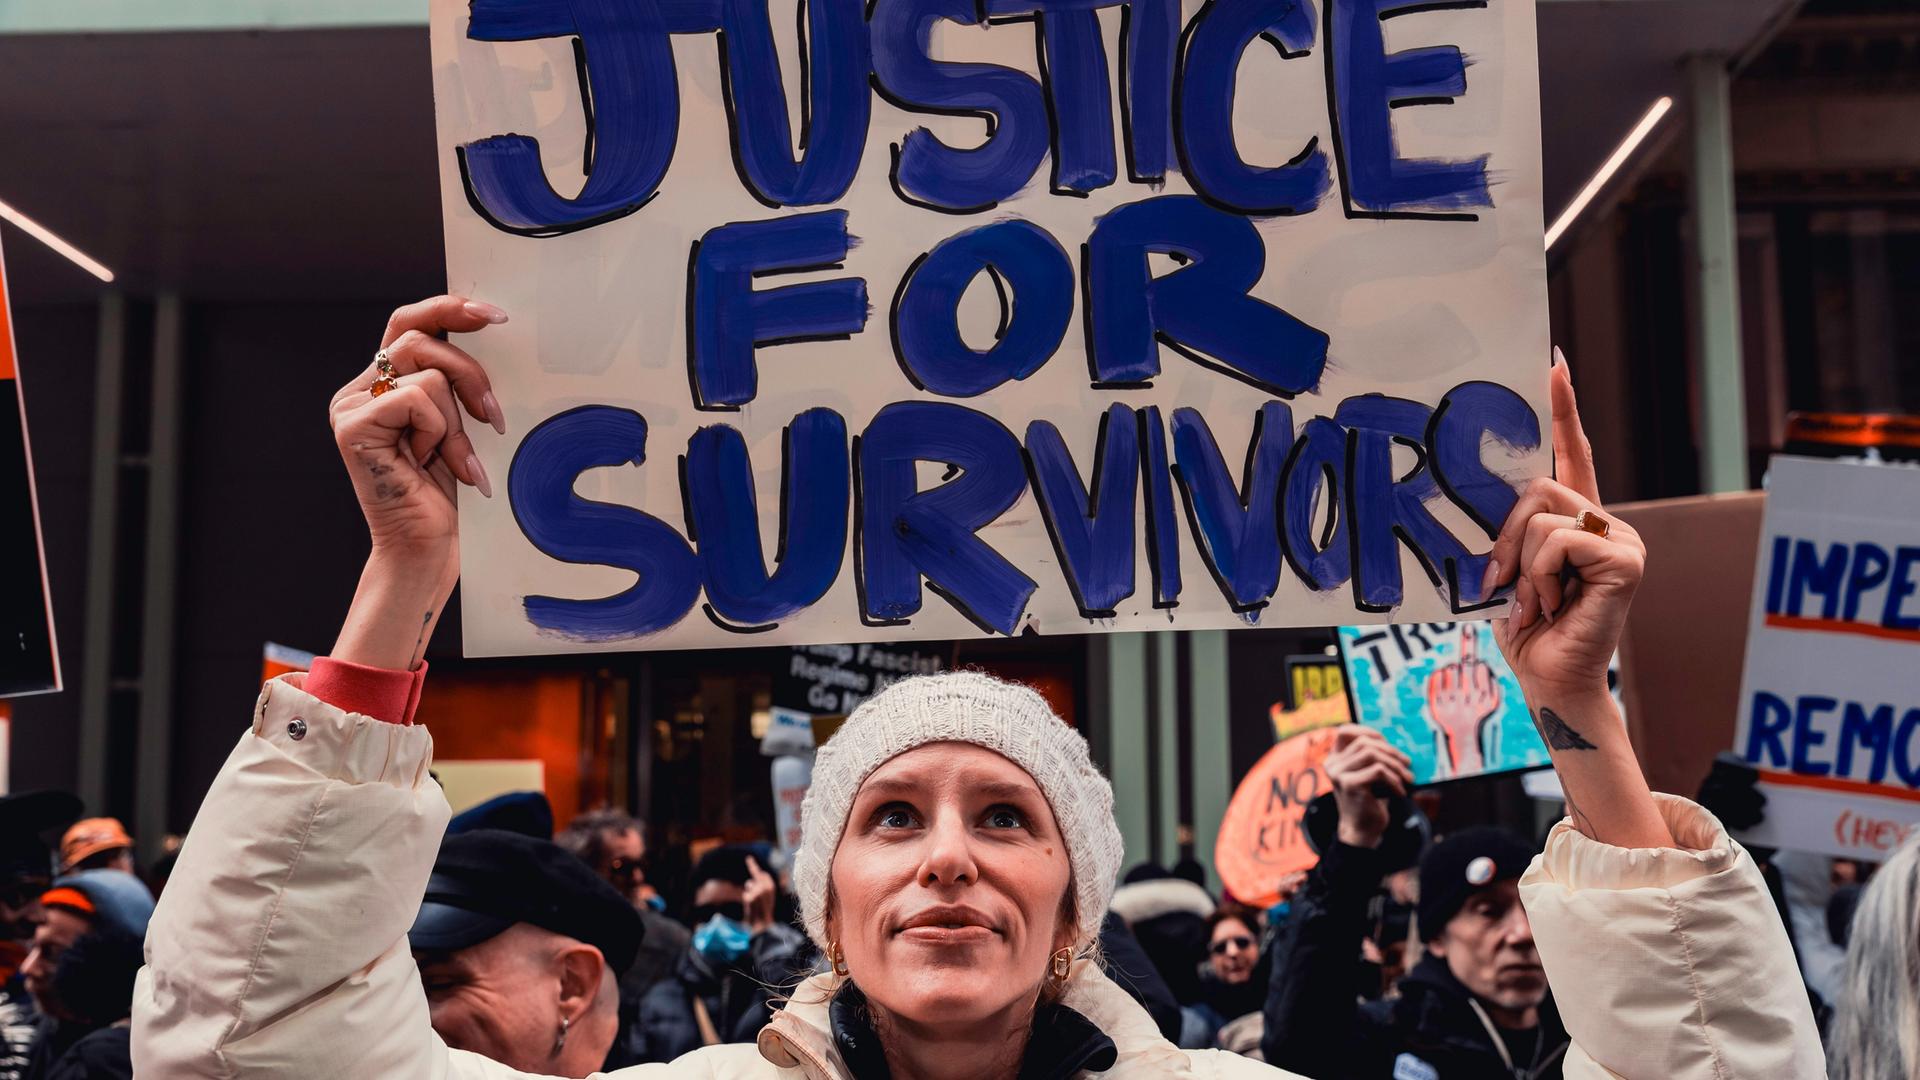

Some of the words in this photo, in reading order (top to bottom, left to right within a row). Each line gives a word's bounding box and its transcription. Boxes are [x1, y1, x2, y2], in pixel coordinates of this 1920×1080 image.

[456, 0, 1498, 237] JUSTICE
[686, 195, 1332, 411] FOR
[507, 380, 1542, 642] SURVIVORS
[1765, 535, 1920, 630] IMPE
[790, 655, 869, 691] Regime
[857, 644, 942, 676] Fascist
[807, 684, 838, 711] Go
[1266, 769, 1318, 813] NO
